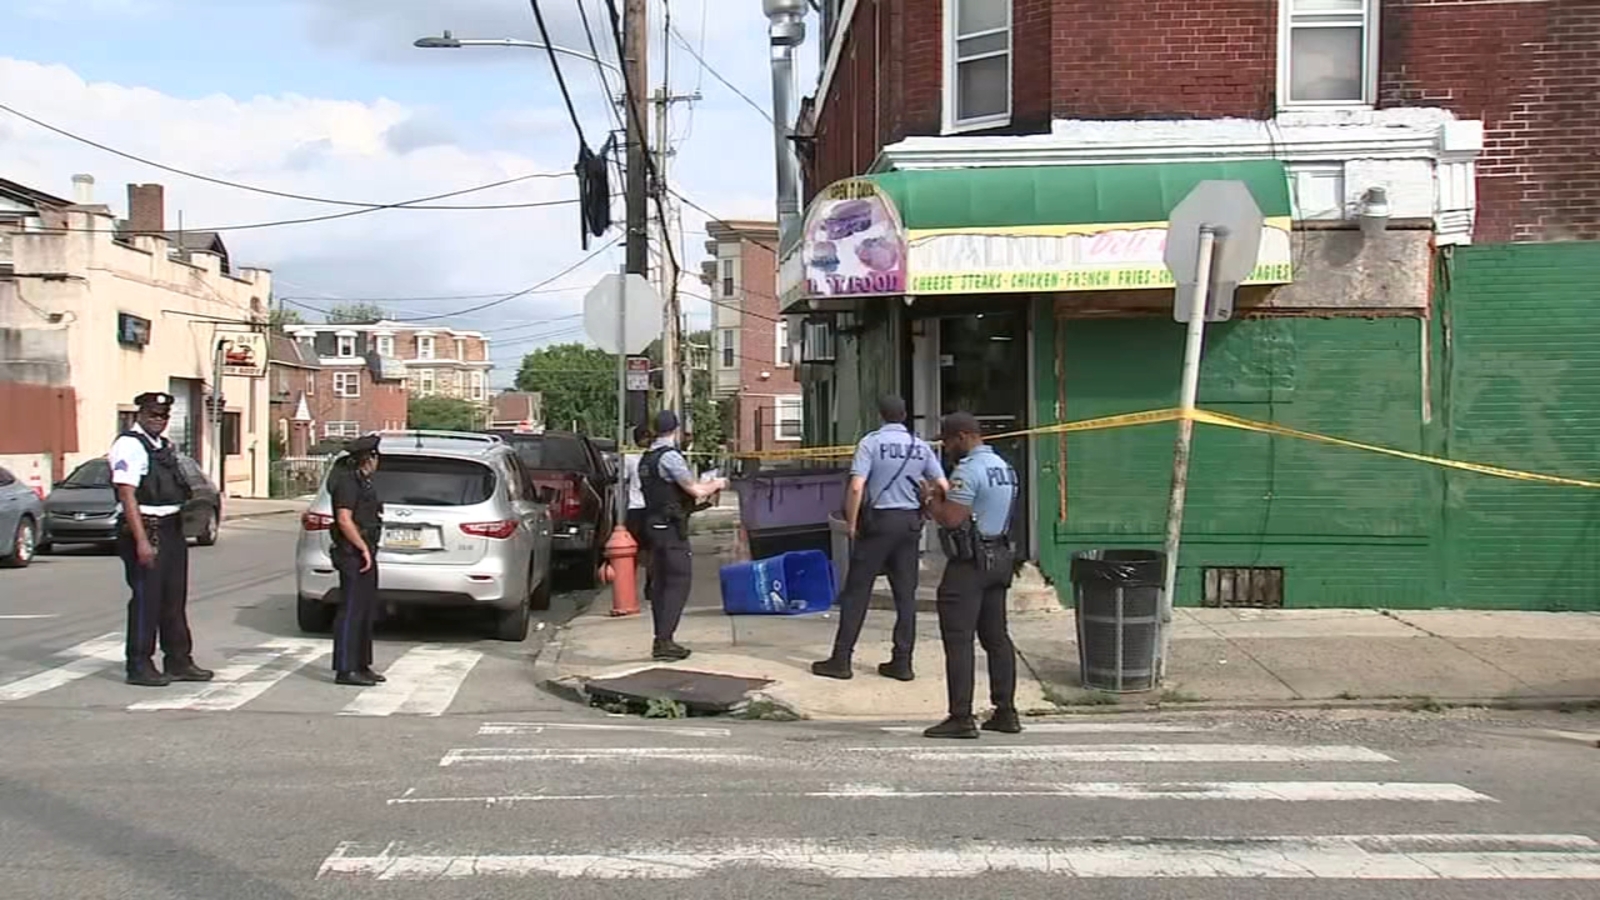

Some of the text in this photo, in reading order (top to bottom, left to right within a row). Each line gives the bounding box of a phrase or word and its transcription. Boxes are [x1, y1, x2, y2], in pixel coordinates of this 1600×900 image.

[912, 275, 953, 291] CHEESE
[1243, 264, 1290, 281] AGIES
[880, 443, 925, 461] POLICE
[986, 466, 1017, 488] POLI
